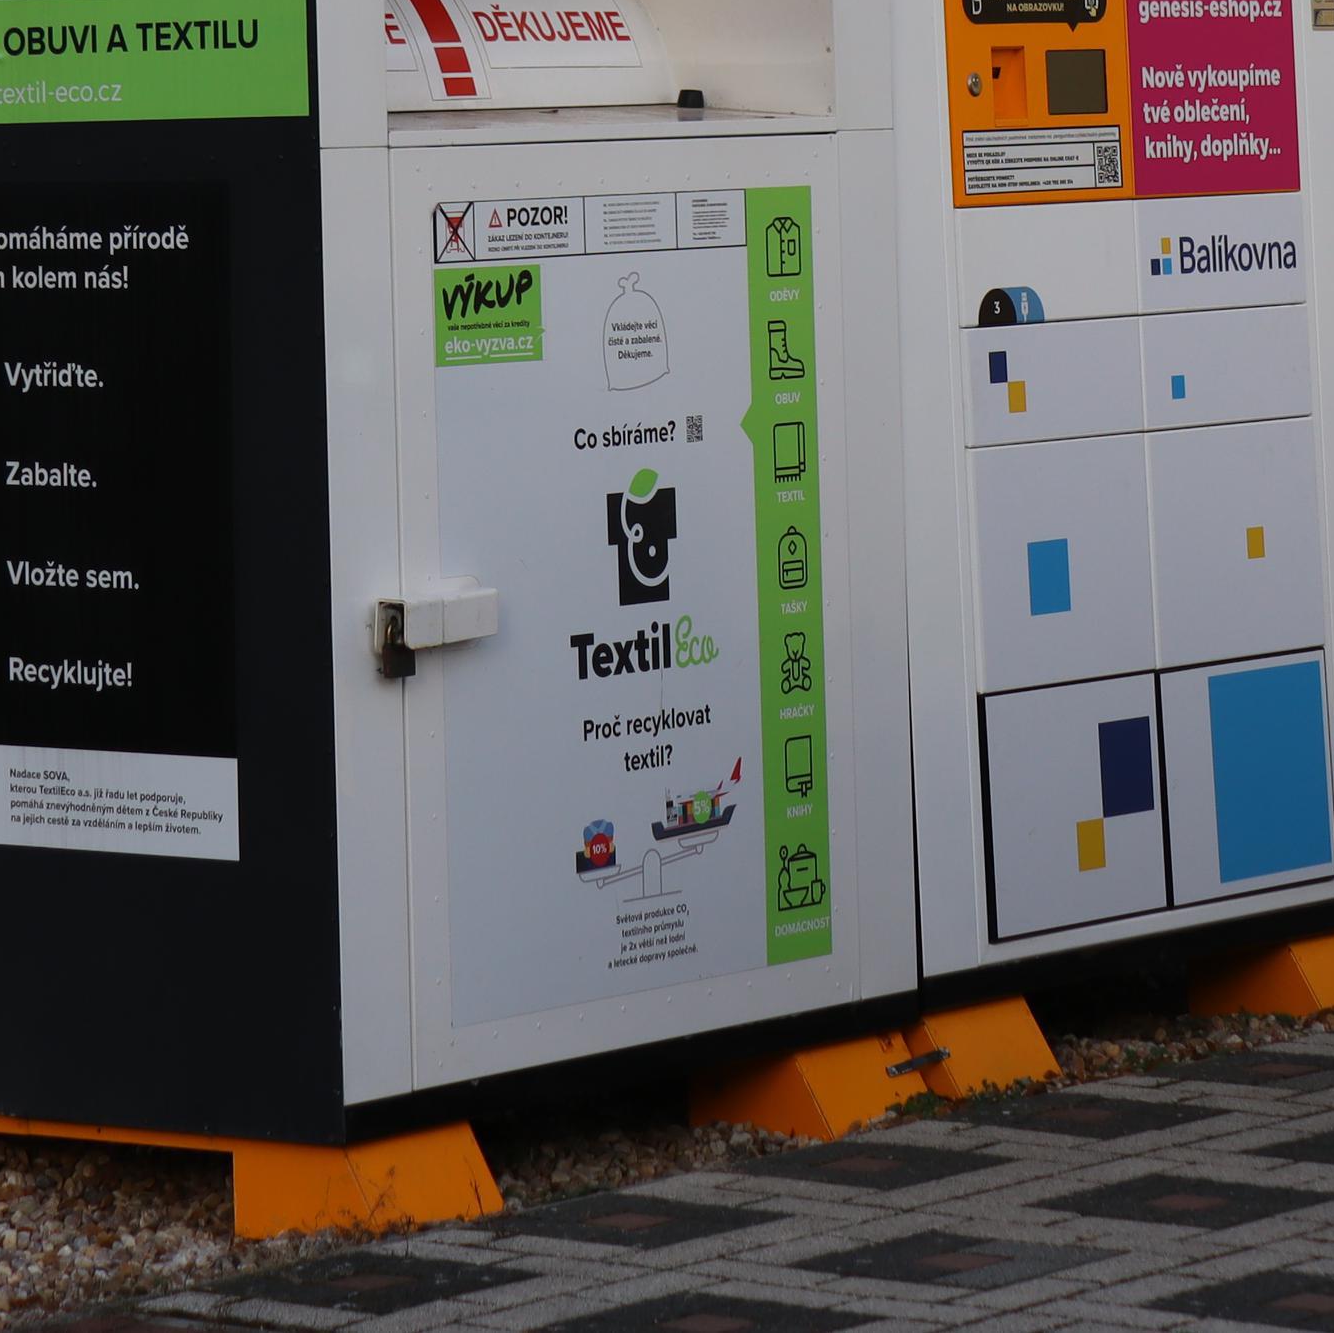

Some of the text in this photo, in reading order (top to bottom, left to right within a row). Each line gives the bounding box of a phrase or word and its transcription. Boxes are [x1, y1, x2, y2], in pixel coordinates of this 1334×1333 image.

[1007, 2, 1018, 12] NA
[472, 4, 631, 42] DĚKUJEME
[3, 24, 97, 57] OBUVI
[107, 23, 127, 53] A
[136, 19, 259, 52] TEXTILU
[1141, 62, 1280, 93] Nově vykoupíme
[1143, 98, 1250, 126] tvé oblečení,
[1145, 129, 1281, 165] knihy, doplňky...
[507, 205, 568, 227] POZOR!
[109, 224, 189, 255] přírodě
[525, 233, 532, 241] DO
[1179, 234, 1297, 274] Balíkovna
[12, 264, 77, 289] kolem
[84, 265, 129, 289] nás!
[442, 269, 533, 320] VÝKUP
[769, 289, 800, 302] ODĚVY
[994, 302, 1001, 314] 3
[445, 336, 533, 355] eko-vyzva.cz
[4, 361, 104, 393] Vytřiďte.
[775, 392, 800, 405] OBUV
[574, 420, 676, 450] Co sbíráme?
[6, 461, 97, 487] Zabalte.
[776, 490, 805, 503] TEXTIL
[7, 560, 140, 590] Vložte sem.
[781, 600, 808, 615] TAŠKY
[9, 657, 133, 692] Recyklujte!
[583, 705, 711, 742] Proč recyklovat
[779, 703, 815, 720] HRAČKY
[624, 744, 673, 772] textil?
[10, 768, 70, 782] Nadace SOVA,
[10, 784, 37, 794] kterou
[38, 785, 76, 797] TextilEco
[105, 788, 124, 800] řadu
[127, 789, 138, 801] let
[140, 791, 186, 805] podporuje,
[10, 798, 44, 811] pomáhá
[116, 803, 143, 816] dětem
[152, 806, 178, 819] České
[180, 809, 223, 823] Republiky
[694, 800, 711, 815] 5%
[787, 804, 813, 819] KNIHY
[10, 814, 21, 823] na
[71, 818, 81, 827] za
[592, 844, 607, 855] 10%
